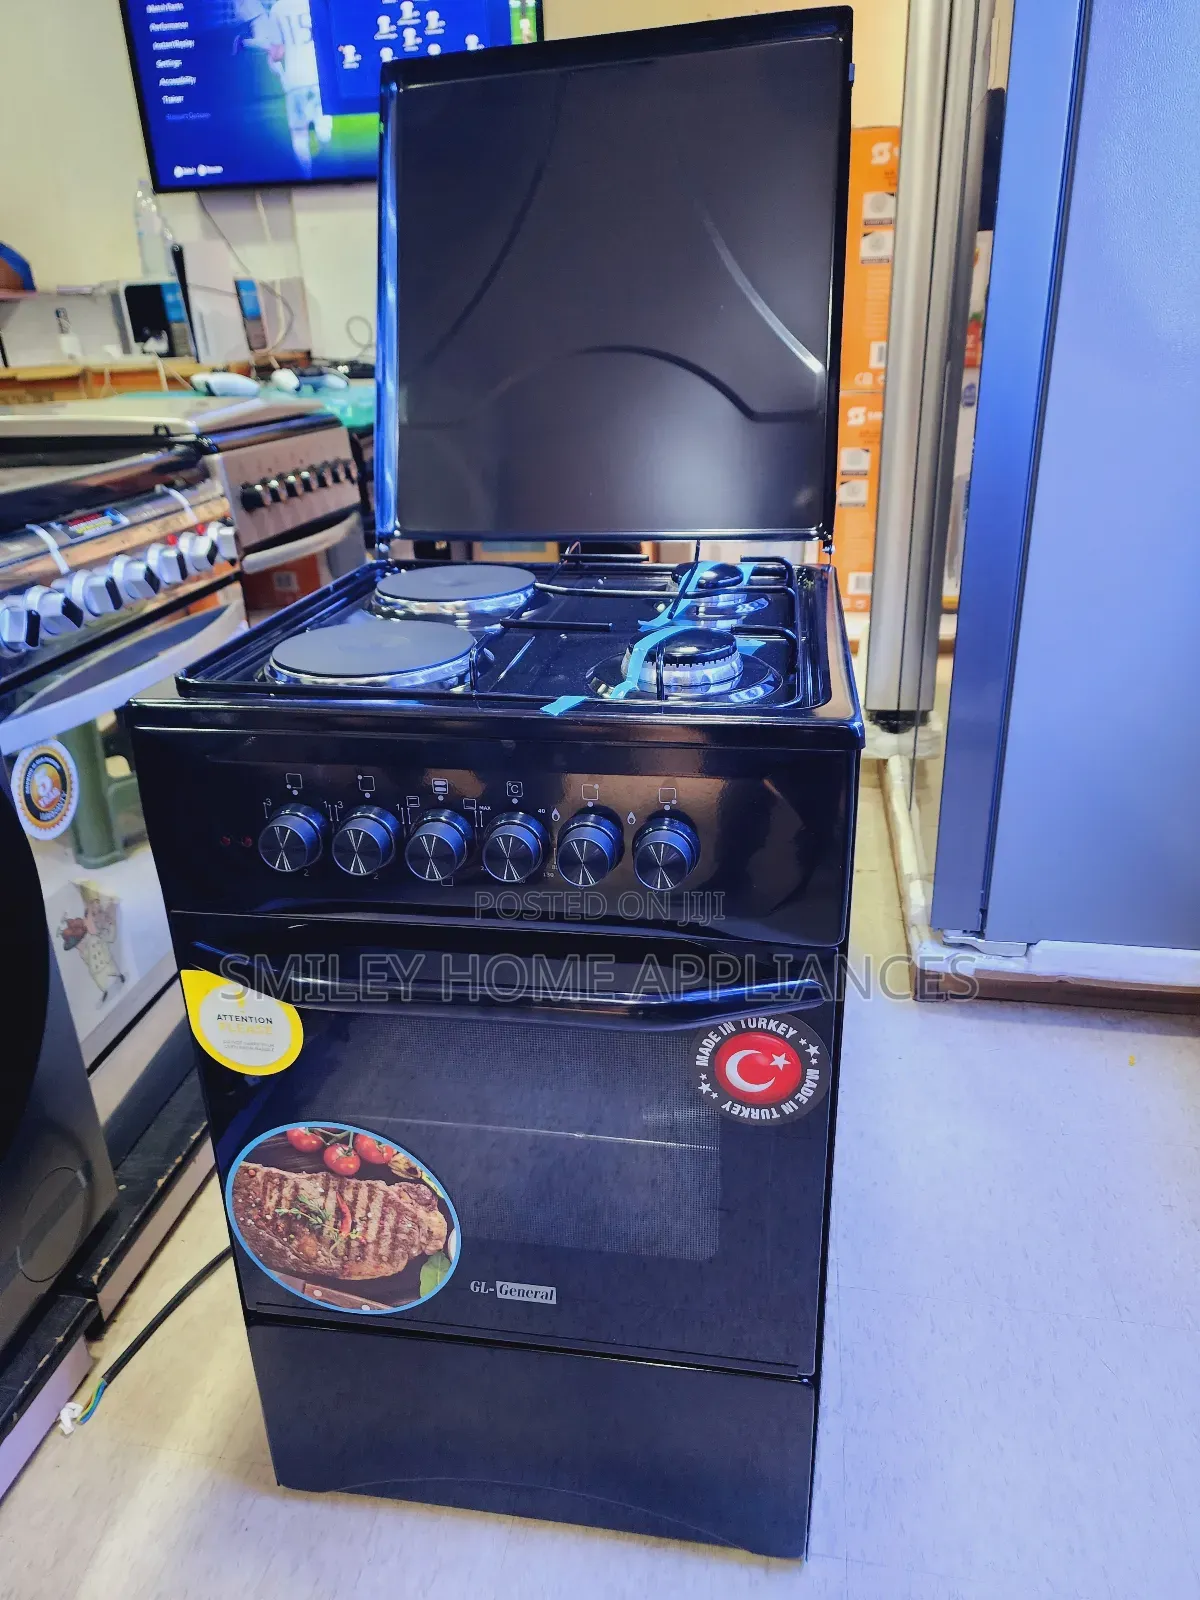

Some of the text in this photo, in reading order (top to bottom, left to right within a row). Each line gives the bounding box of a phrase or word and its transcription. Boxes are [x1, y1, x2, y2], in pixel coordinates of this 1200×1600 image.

[265, 798, 272, 806] 3
[337, 801, 344, 809] 3
[303, 869, 310, 877] 2
[373, 872, 379, 880] 2
[216, 1013, 273, 1025] ATTENTION
[218, 1022, 273, 1035] PLEASE
[696, 1017, 798, 1067] MADE IN TURKEY
[721, 1068, 820, 1120] MADE IN TURKEY
